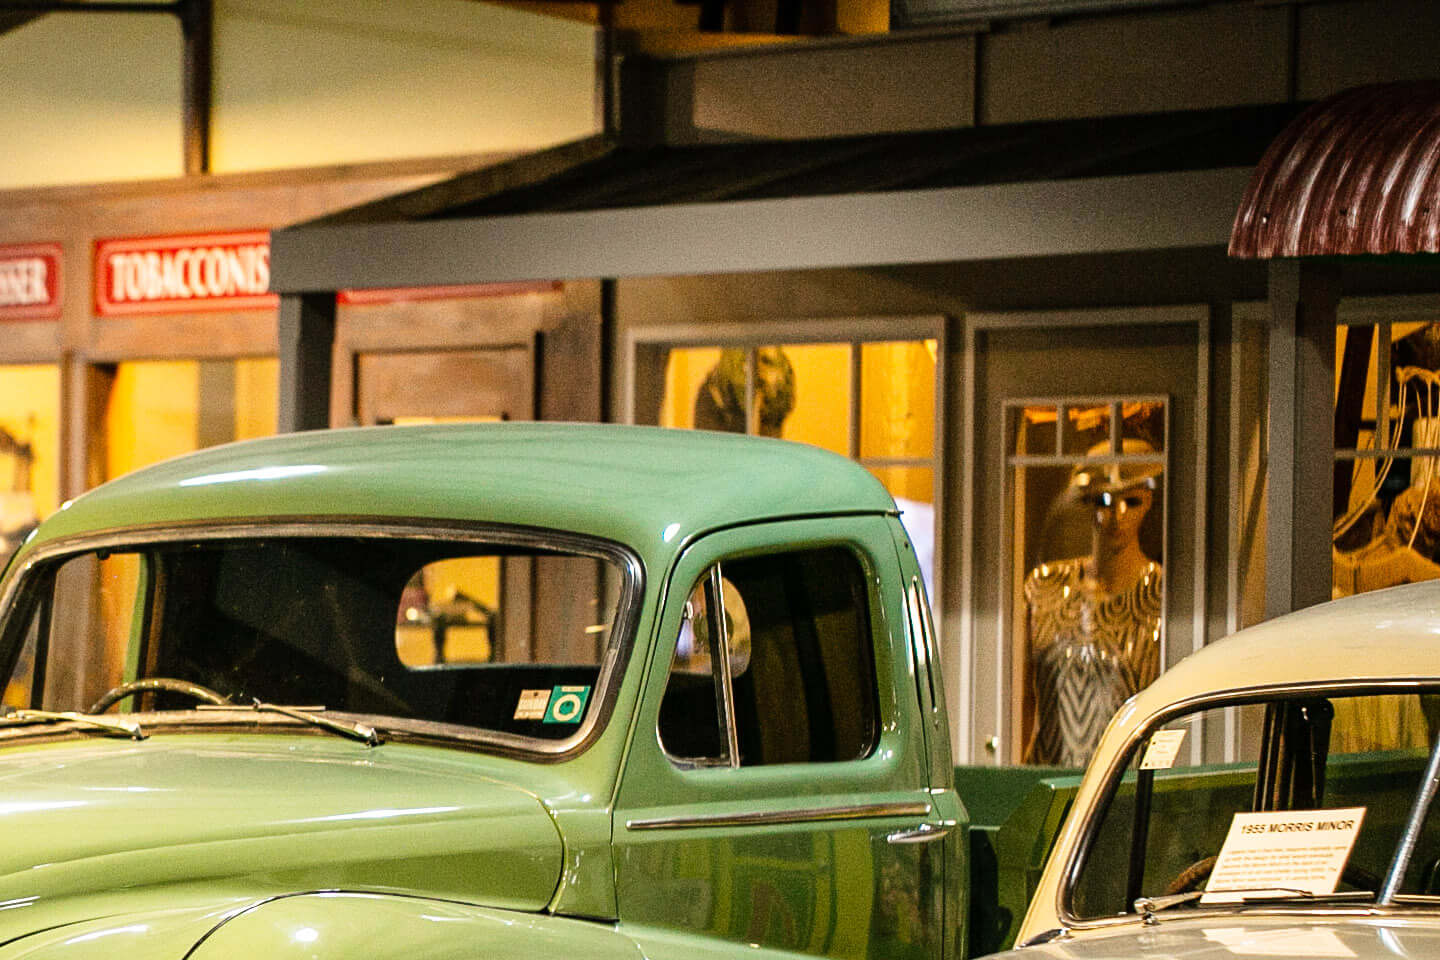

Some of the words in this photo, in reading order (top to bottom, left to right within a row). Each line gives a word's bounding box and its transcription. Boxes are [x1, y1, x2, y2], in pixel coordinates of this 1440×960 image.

[111, 244, 270, 301] TOBACCONIS
[1268, 821, 1313, 833] MORRIS
[1317, 819, 1355, 831] MINOR
